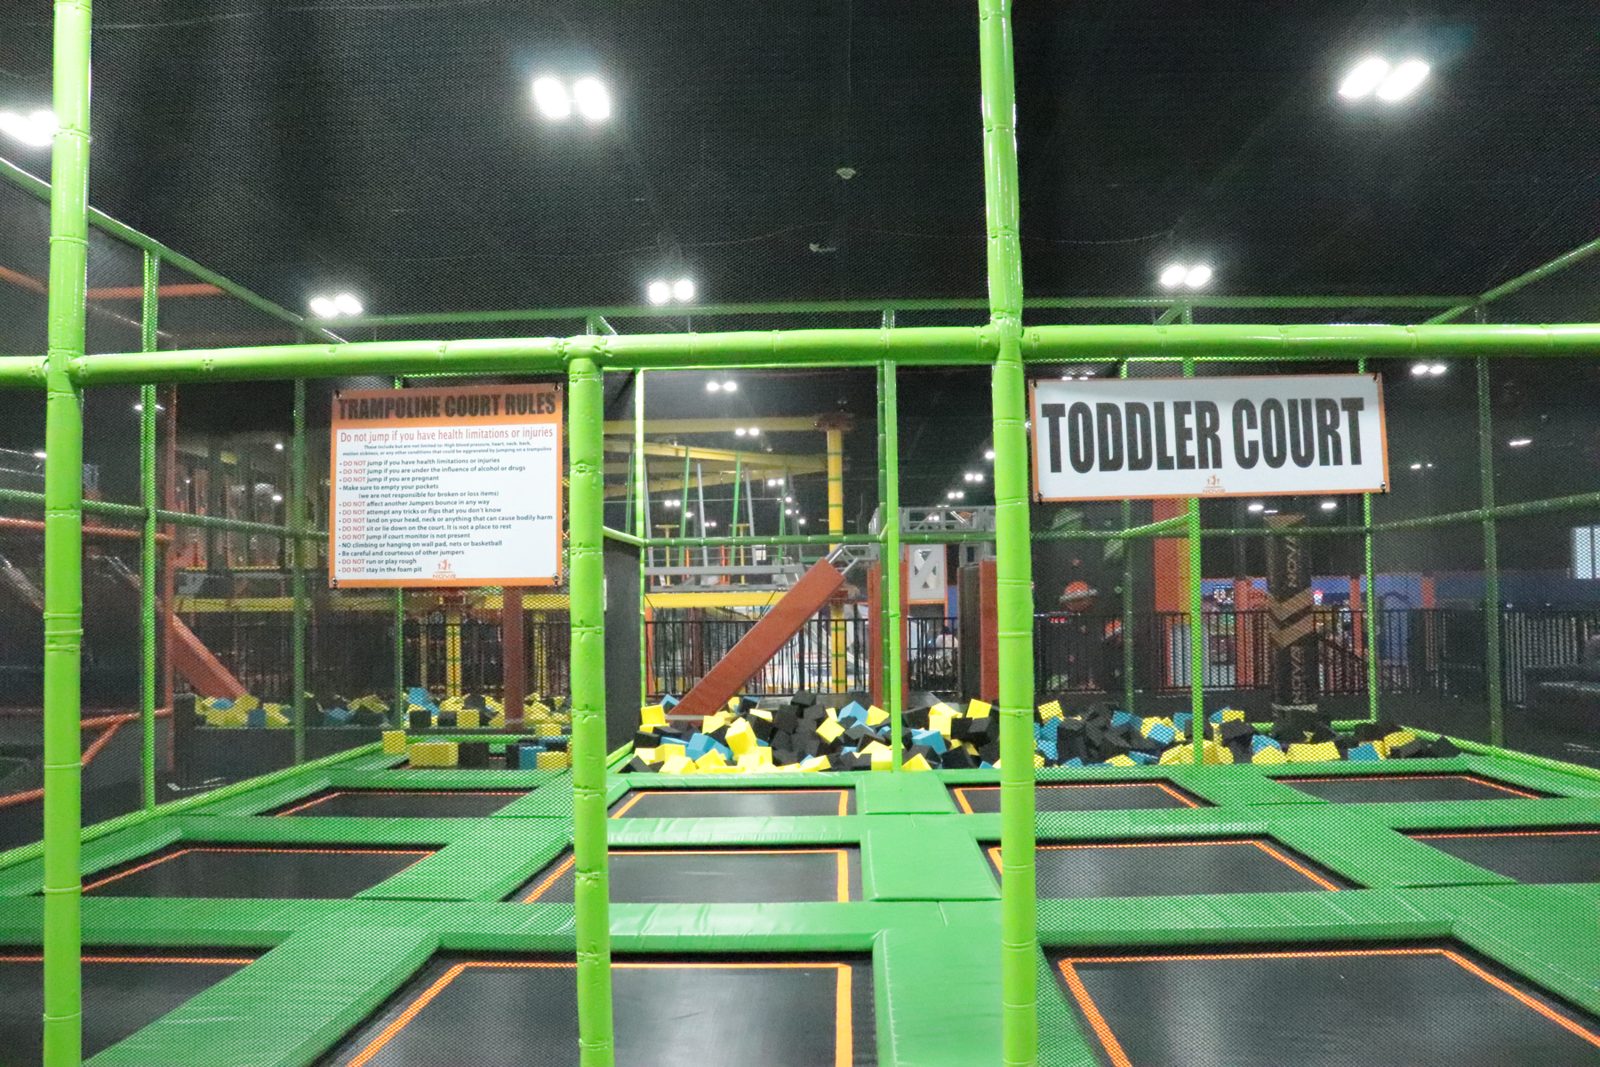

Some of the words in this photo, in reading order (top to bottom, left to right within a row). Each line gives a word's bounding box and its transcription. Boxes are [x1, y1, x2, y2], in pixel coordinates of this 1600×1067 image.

[339, 395, 440, 420] TRAMPOLINE
[445, 393, 500, 417] COURT
[504, 392, 555, 415] RULES
[340, 432, 353, 442] Do
[353, 432, 366, 442] not
[367, 431, 389, 443] jump
[391, 431, 397, 440] if
[399, 432, 414, 442] you
[416, 430, 435, 440] have
[438, 429, 463, 439] health
[465, 428, 508, 439] limitations
[522, 426, 552, 438] injuries
[1041, 399, 1222, 473] TODDLER
[1232, 397, 1364, 469] COURT
